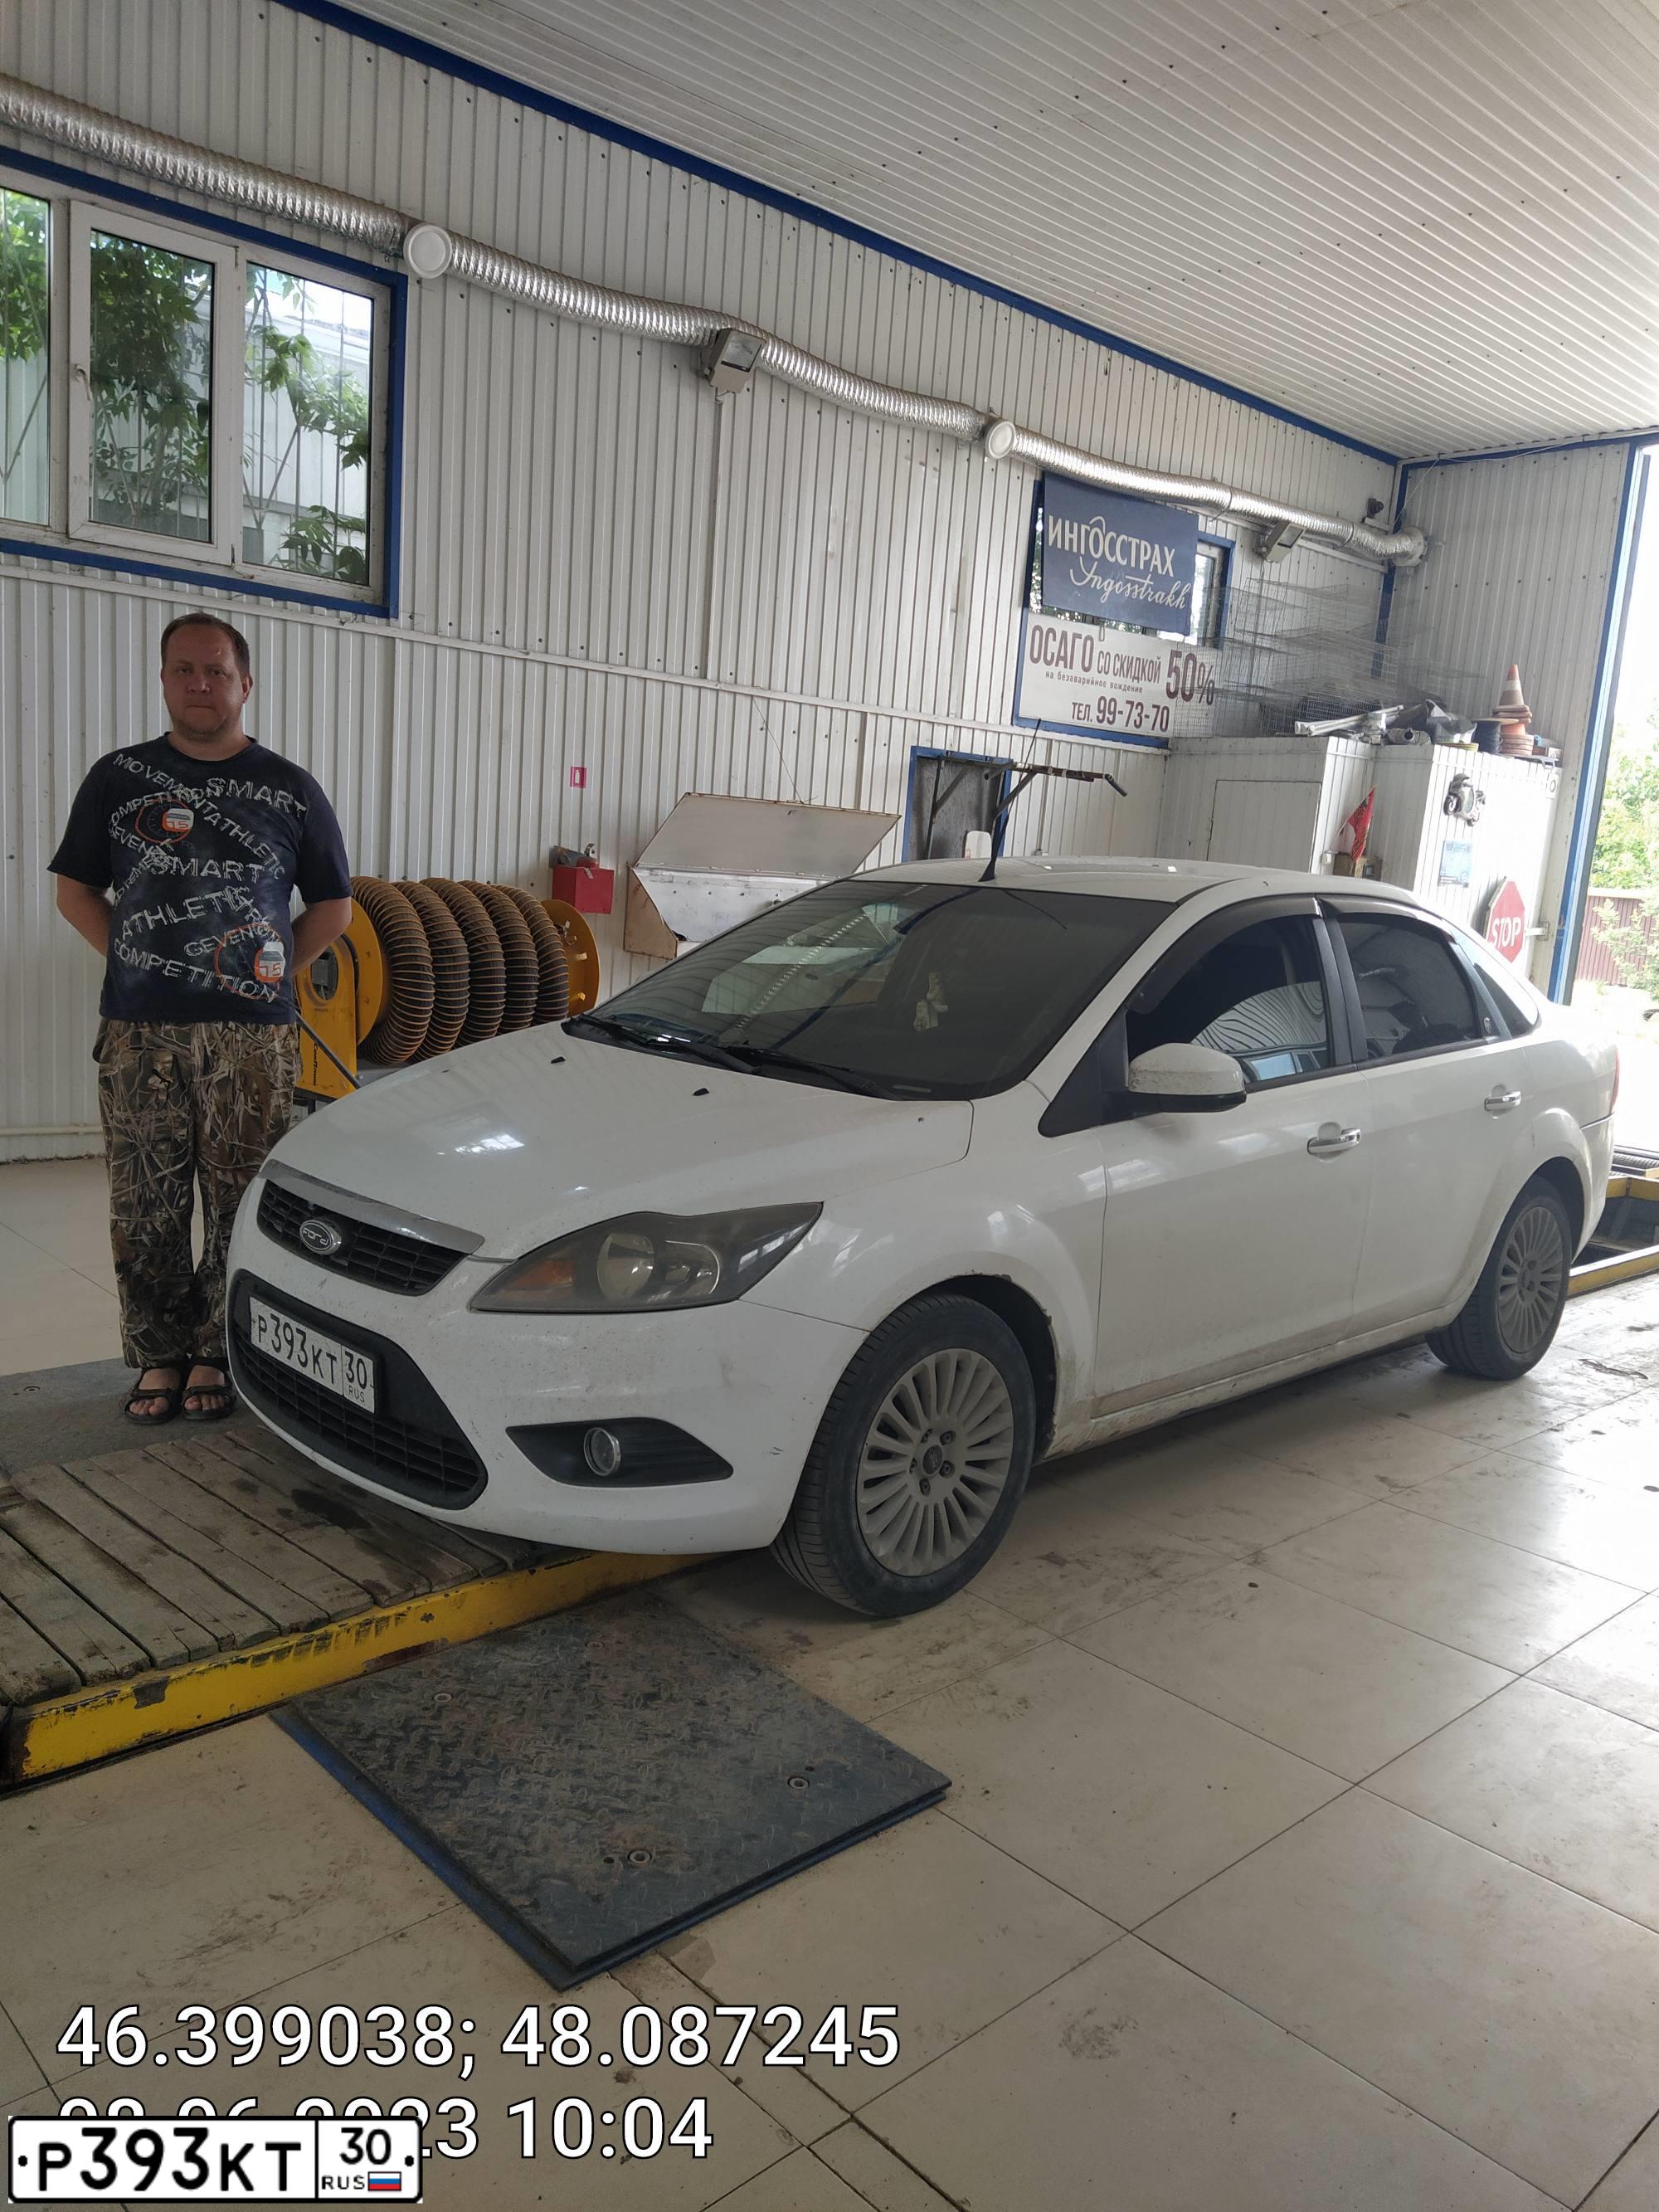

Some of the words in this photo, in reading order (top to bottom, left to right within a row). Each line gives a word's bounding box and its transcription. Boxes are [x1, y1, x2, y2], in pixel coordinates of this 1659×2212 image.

[1048, 515, 1175, 577] ИНГОССТРАХ
[1070, 557, 1191, 609] Ingosstrakh
[1029, 625, 1095, 673] ОСАГО
[1165, 650, 1214, 705] 50%
[1045, 671, 1054, 680] на
[1057, 672, 1107, 689] безаварийное
[1110, 681, 1144, 694] вождение
[1072, 701, 1092, 723] ТЕЛ.
[1096, 695, 1170, 733] 99-73-70
[207, 777, 307, 819] SMART
[1492, 917, 1521, 948] STOP
[344, 1351, 367, 1390] 30
[349, 1386, 365, 1403] RUS
